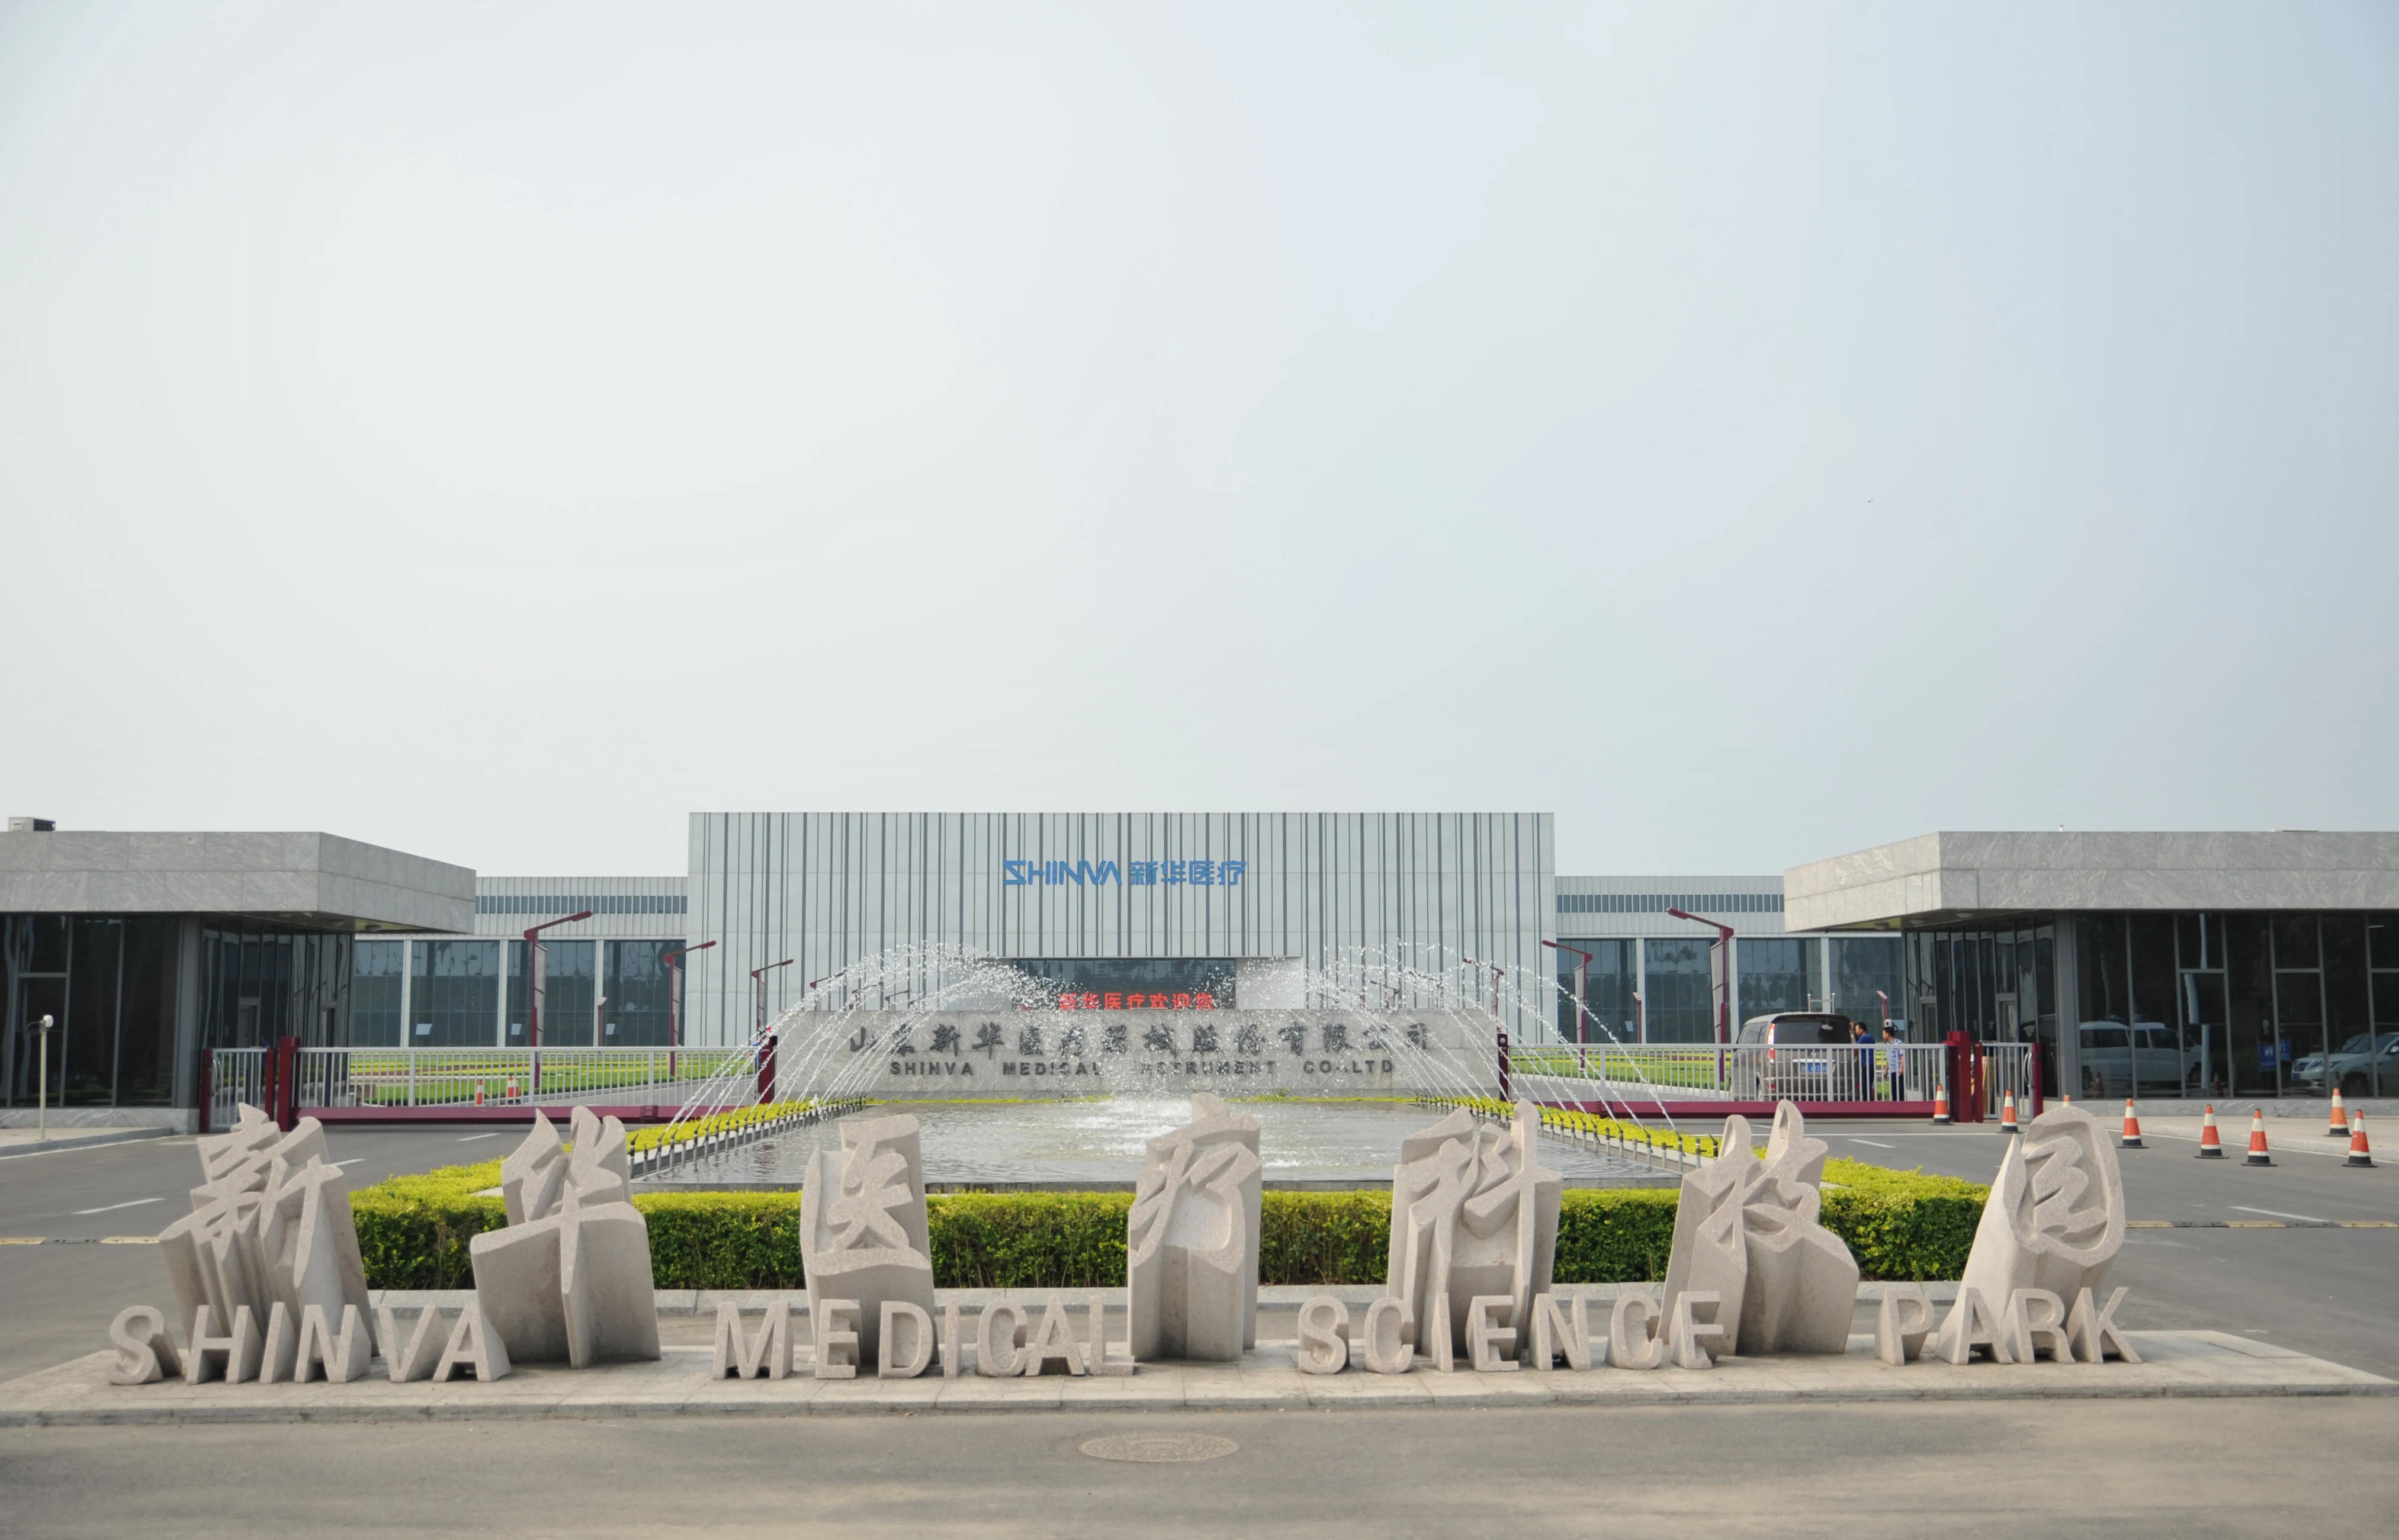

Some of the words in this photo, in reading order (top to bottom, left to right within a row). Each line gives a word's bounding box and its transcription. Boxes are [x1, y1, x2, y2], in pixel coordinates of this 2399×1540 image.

[1003, 860, 1122, 886] SHINVA
[1130, 860, 1247, 886] 新华医疗
[1058, 992, 1213, 1010] 新华医疗欢迎您
[890, 1061, 974, 1075] SHINVA
[1003, 1062, 1101, 1075] MEDICAL
[1133, 1061, 1275, 1075] NSTRUMENT
[109, 1301, 512, 1385] SHINVA
[712, 1294, 1136, 1380] MEDICAL
[1876, 1286, 2143, 1366] PARK
